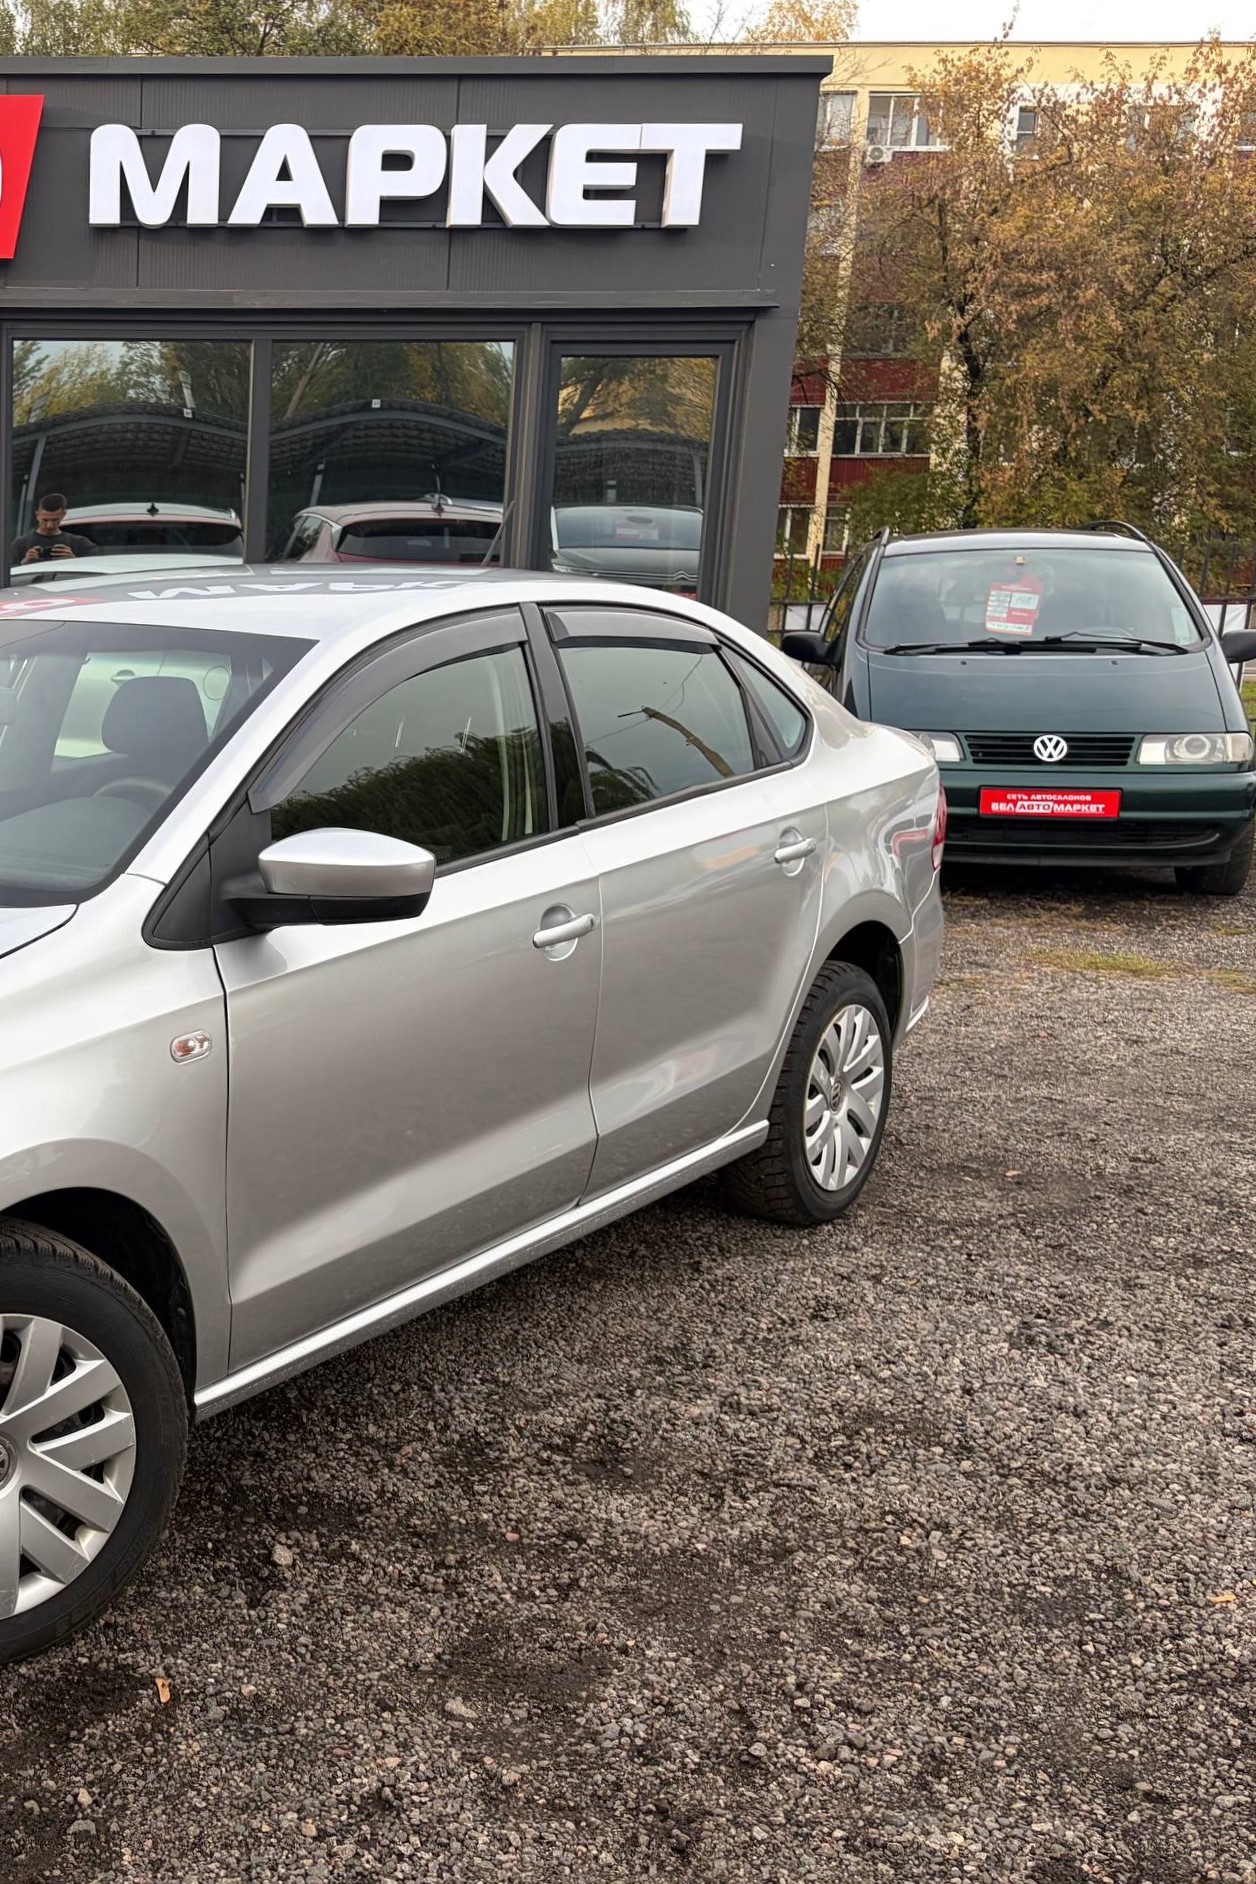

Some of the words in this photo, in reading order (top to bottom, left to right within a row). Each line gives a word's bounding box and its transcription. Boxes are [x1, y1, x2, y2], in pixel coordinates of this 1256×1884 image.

[89, 123, 743, 230] МАРКЕТ
[1006, 793, 1029, 801] СЕТЬ
[1030, 793, 1092, 802] АВТОСАЛОНОВ
[991, 802, 1015, 813] БЕЛ
[1017, 803, 1051, 811] АВТО
[1053, 803, 1105, 813] МАРКЕТ
